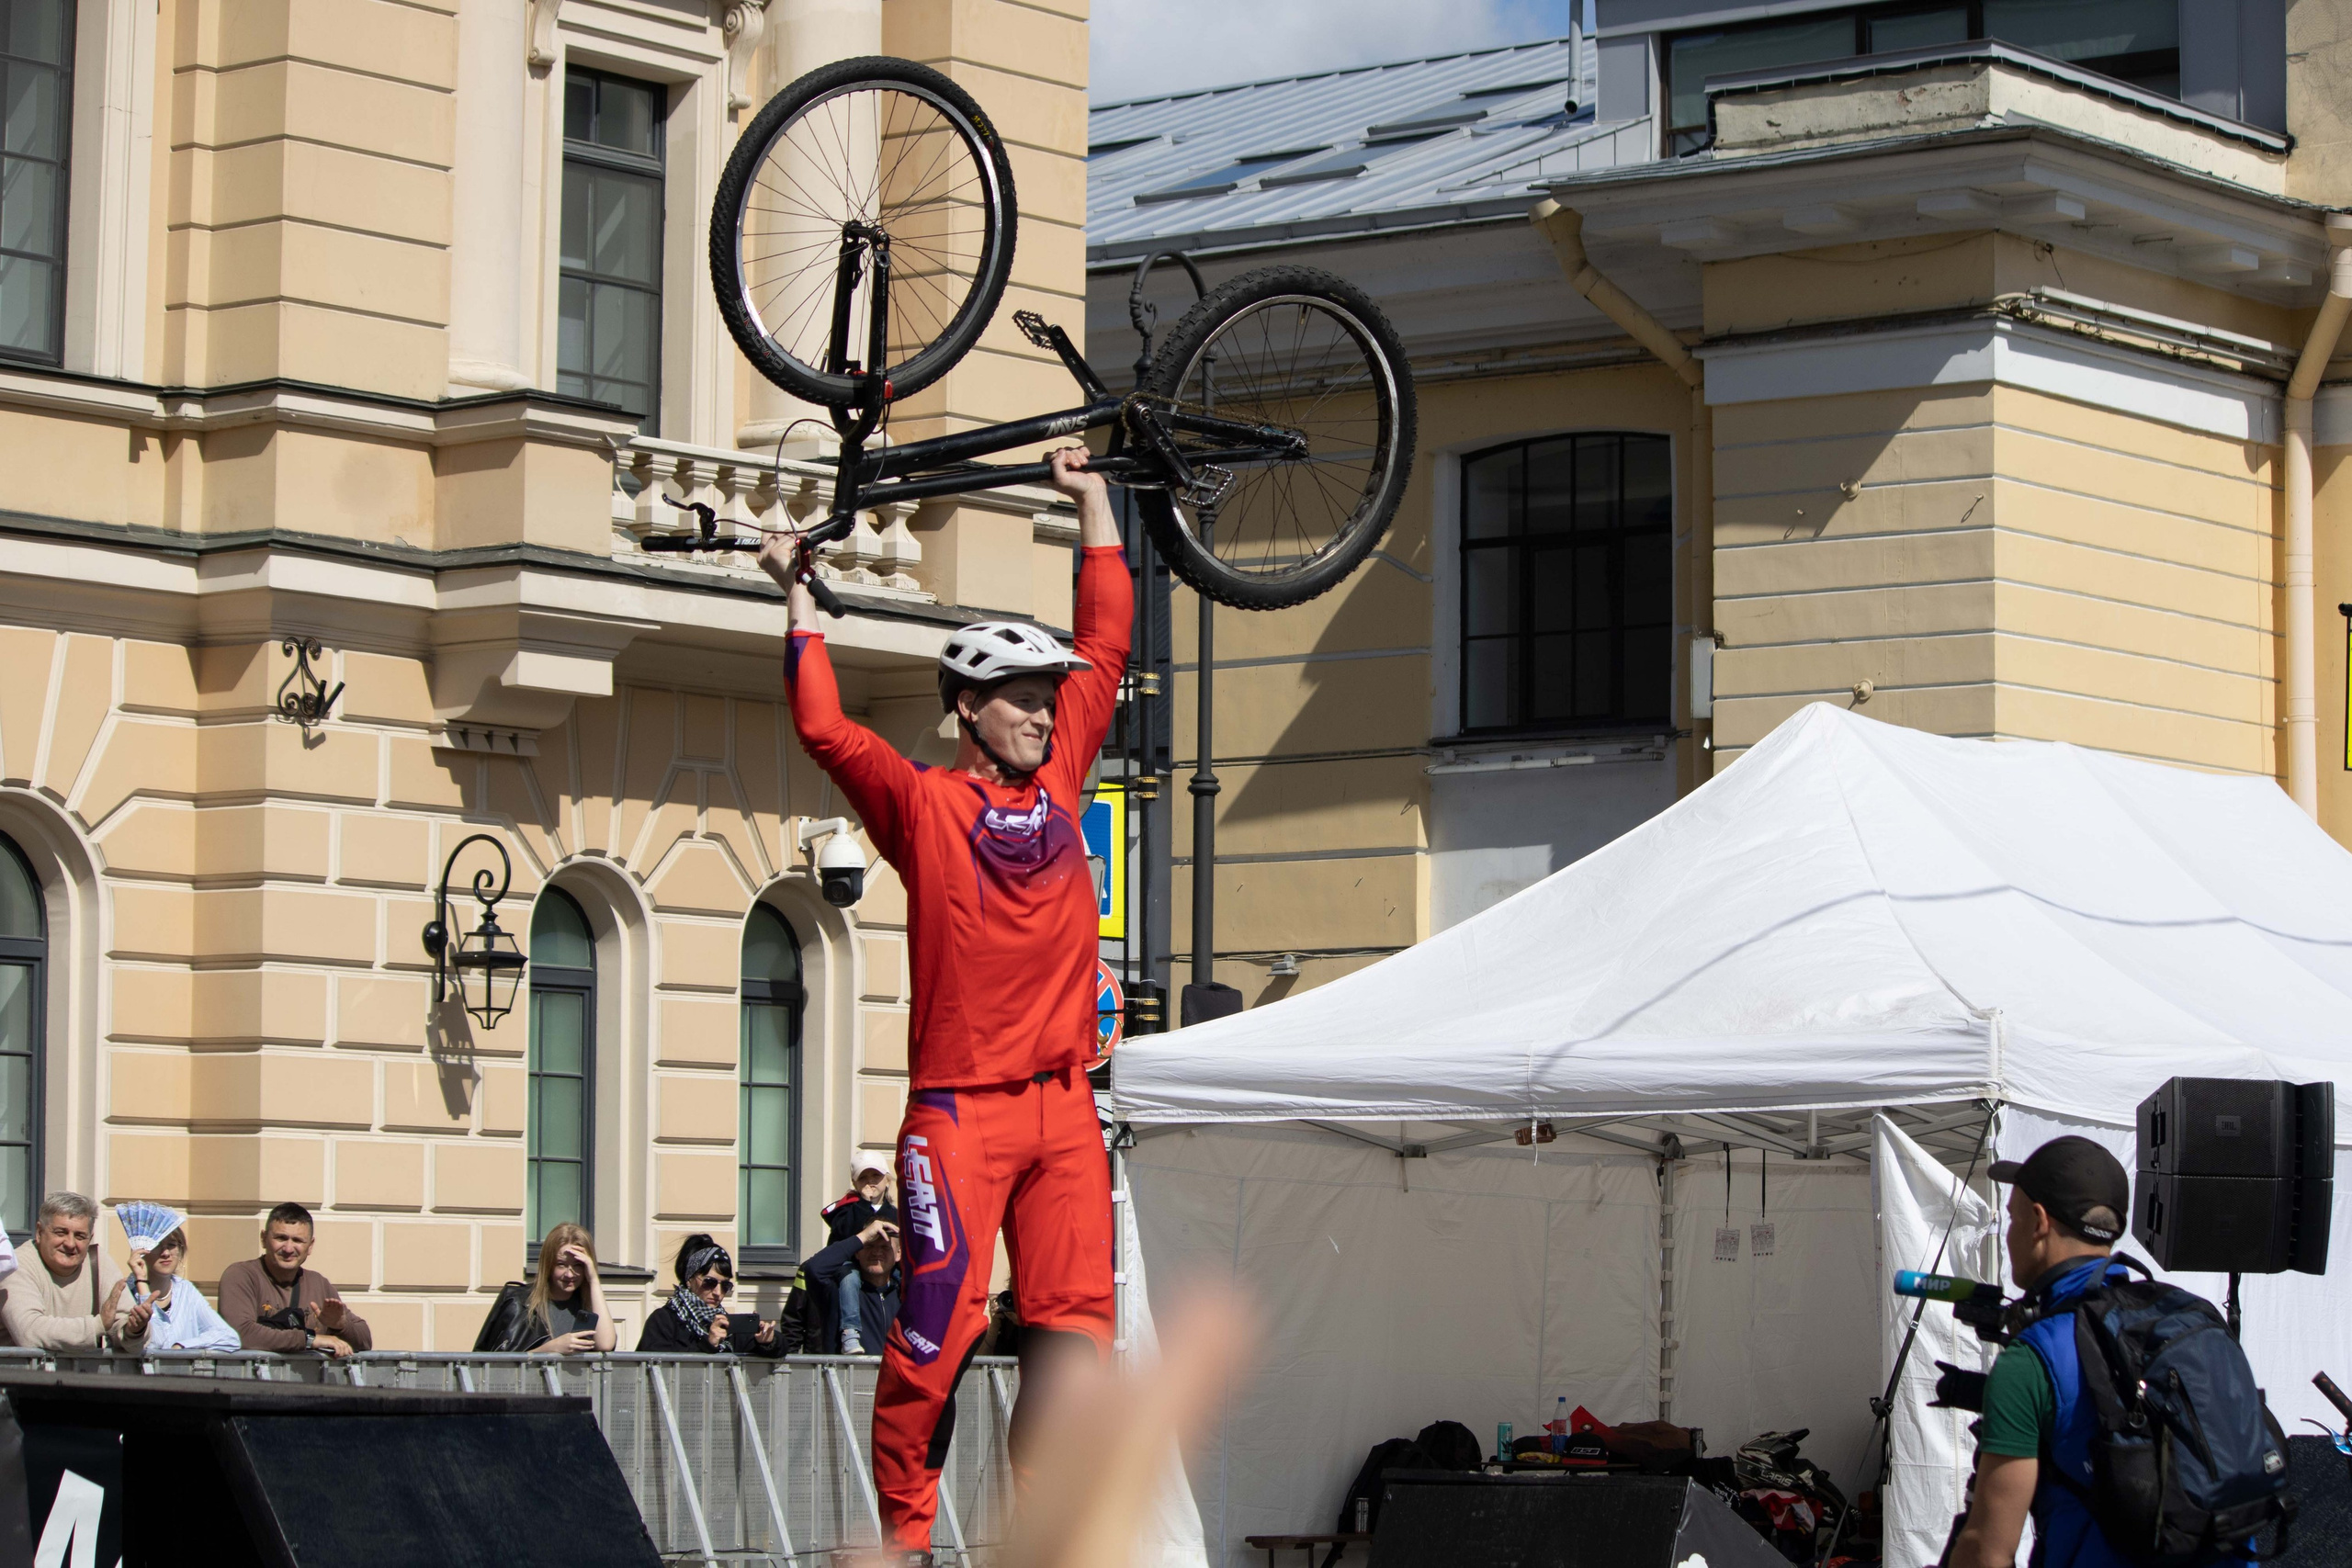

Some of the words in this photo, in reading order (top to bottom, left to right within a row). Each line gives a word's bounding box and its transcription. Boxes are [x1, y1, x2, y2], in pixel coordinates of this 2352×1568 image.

[1044, 414, 1088, 437] SAW
[903, 1134, 944, 1252] LEATT
[2084, 1225, 2113, 1239] LONDON
[1914, 1276, 1951, 1291] МИР
[904, 1326, 940, 1355] LEATT
